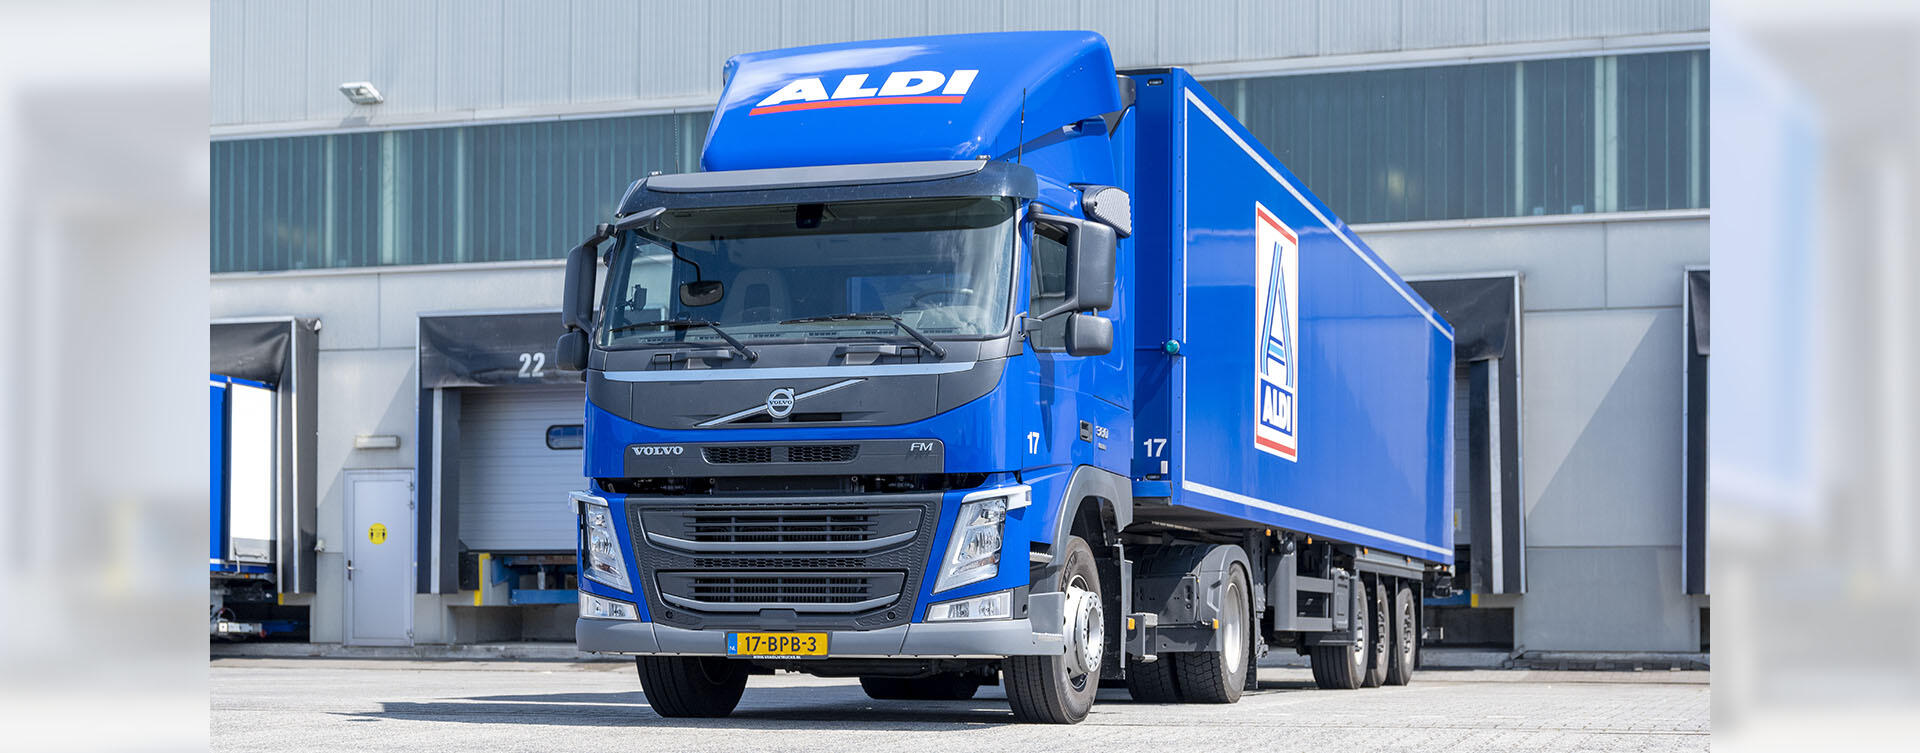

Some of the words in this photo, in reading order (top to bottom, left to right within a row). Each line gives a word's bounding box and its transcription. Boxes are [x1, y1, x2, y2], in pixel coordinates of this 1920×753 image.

[755, 69, 979, 107] ALDI
[518, 352, 546, 378] 22
[1263, 385, 1292, 432] ALDI
[632, 446, 683, 456] VOLVO
[910, 442, 933, 452] FM
[1027, 431, 1040, 455] 17
[1143, 438, 1167, 457] 17
[745, 636, 817, 652] 17-BPB-3
